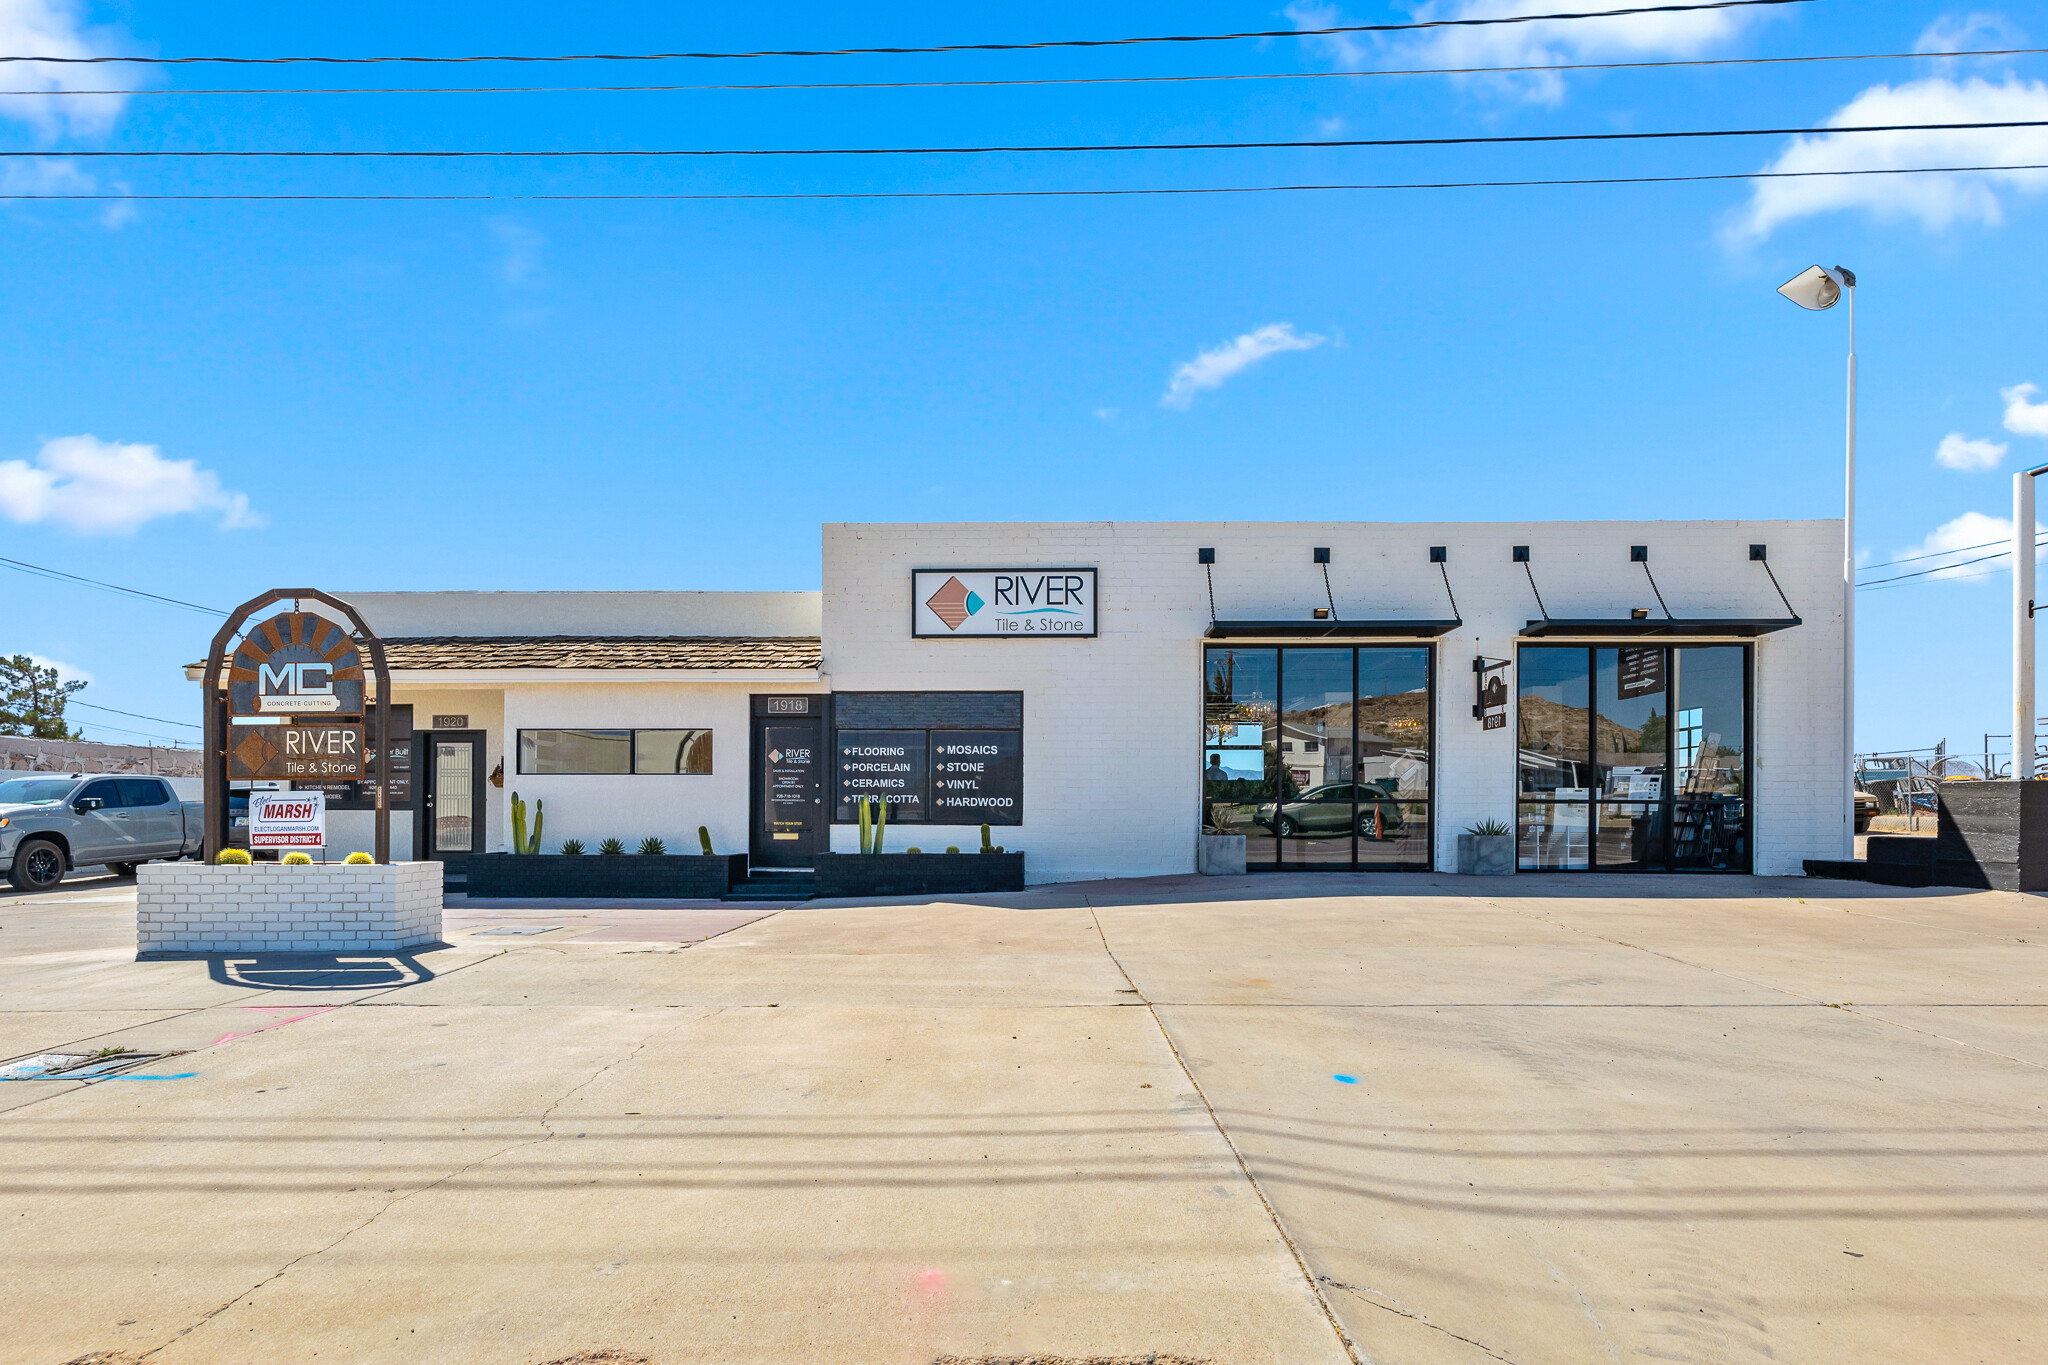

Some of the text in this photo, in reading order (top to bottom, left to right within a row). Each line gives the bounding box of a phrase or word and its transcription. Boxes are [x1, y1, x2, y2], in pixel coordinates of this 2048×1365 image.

[994, 575, 1084, 606] RIVER
[995, 618, 1084, 631] Tile & Stone
[258, 662, 333, 695] MC
[773, 699, 803, 711] 1918
[438, 716, 464, 727] 1920
[286, 730, 356, 755] RIVER
[786, 749, 810, 757] RIVER
[852, 747, 905, 756] FLOORING
[947, 745, 998, 755] MOSAICS
[286, 761, 356, 773] Tile & Stone
[852, 763, 911, 772] PORCELAIN
[946, 762, 985, 772] STONE
[852, 778, 905, 788] CERAMICS
[946, 780, 979, 789] VINYL
[886, 794, 920, 804] COTTA
[946, 797, 1014, 807] HARDWOOD
[263, 803, 313, 819] MARSH
[254, 825, 319, 833] ELECTLOGANMARSH.COM
[254, 835, 320, 844] SUPERVISOR DISTRICT 4
